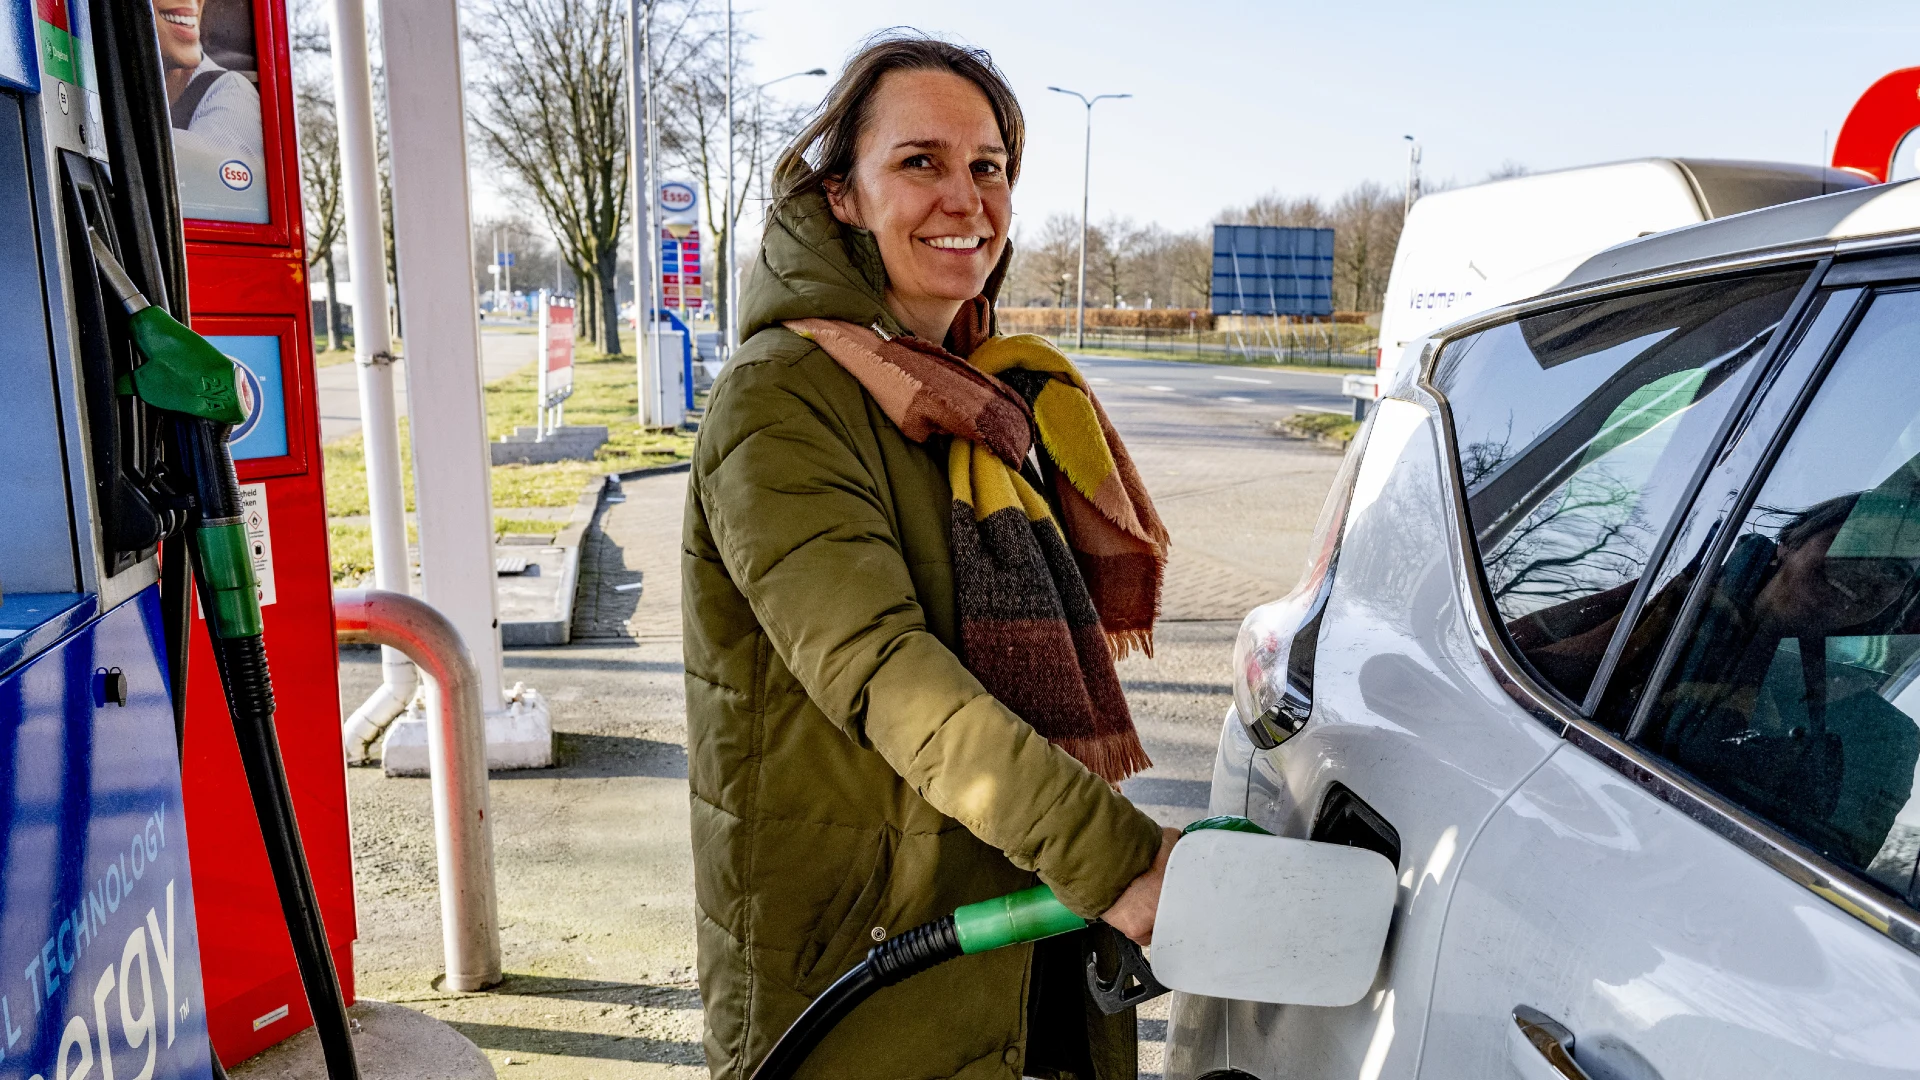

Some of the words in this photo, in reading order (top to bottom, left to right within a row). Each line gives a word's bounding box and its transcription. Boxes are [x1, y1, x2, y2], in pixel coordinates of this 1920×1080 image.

[224, 166, 249, 182] Esso
[662, 189, 691, 202] Esso
[25, 802, 165, 1014] TECHNOLOGY
[28, 878, 175, 1080] ergy
